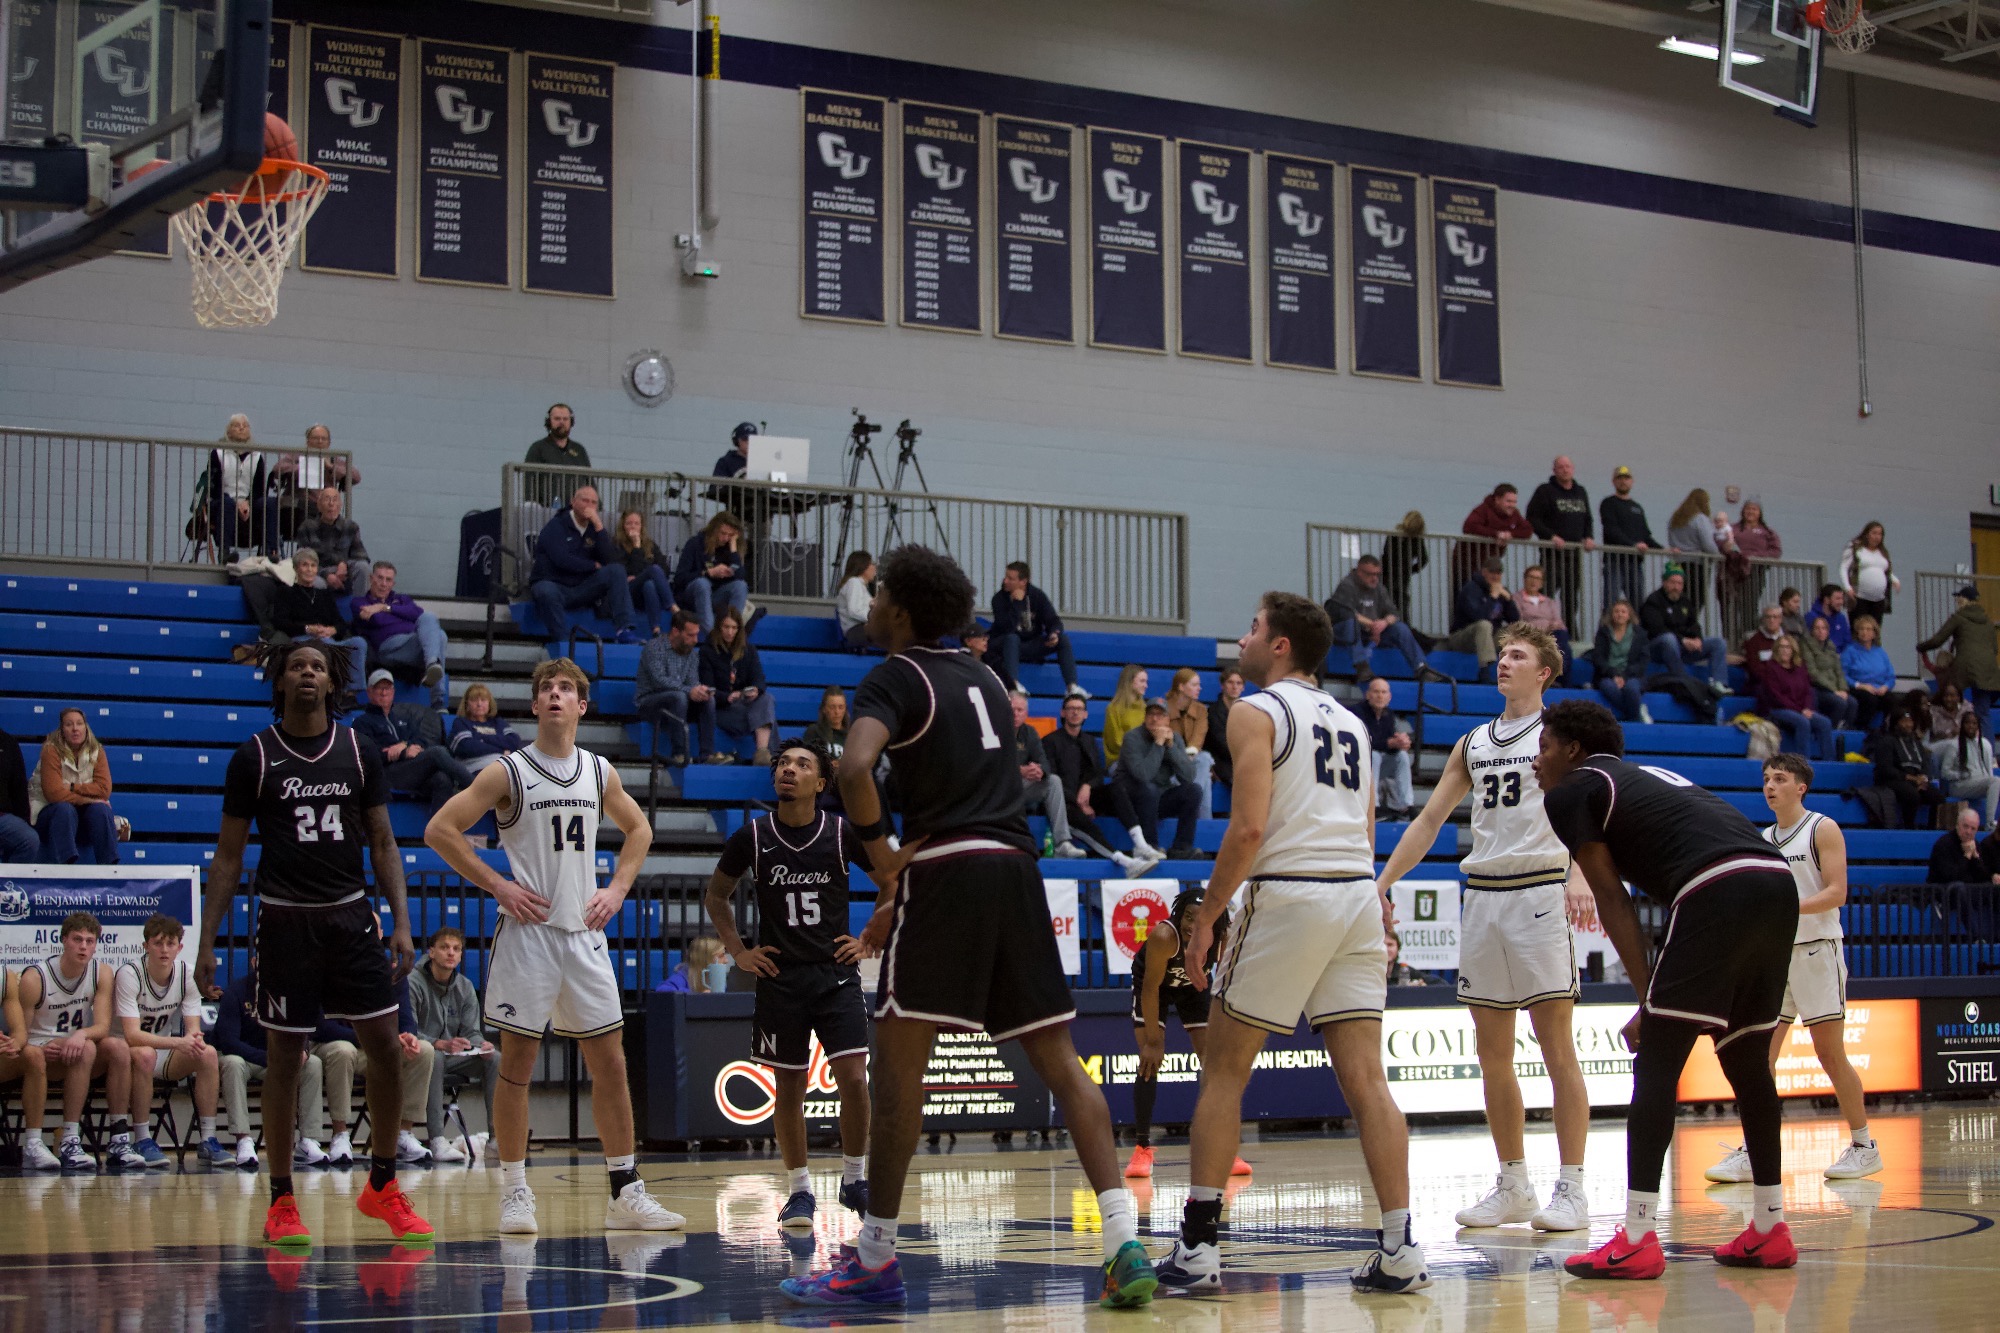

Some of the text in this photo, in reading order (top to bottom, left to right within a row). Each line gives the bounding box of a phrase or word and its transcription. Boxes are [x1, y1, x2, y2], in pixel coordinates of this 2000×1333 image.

[327, 40, 385, 57] WOMEN'S
[328, 54, 383, 69] OUTDOOR
[435, 53, 495, 70] WOMEN'S
[314, 62, 397, 81] TRACK & FIELD
[425, 65, 504, 84] VOLLEYBALL
[542, 68, 600, 84] WOMEN'S
[532, 79, 609, 98] VOLLEYBALL
[95, 111, 149, 124] TOURNAMEN
[826, 104, 862, 118] MEN'S
[807, 113, 881, 131] BASKETBALL
[924, 115, 958, 130] MEN'S
[905, 125, 977, 143] BASKETBALL
[1018, 130, 1050, 144] MEN'S
[336, 138, 372, 152] WHAC
[453, 141, 476, 151] WHAC
[318, 149, 388, 166] CHAMPIONS
[430, 156, 498, 172] CHAMPIONS
[328, 172, 349, 183] 002
[436, 178, 460, 188] 1997
[537, 169, 604, 185] CHAMPIONS
[328, 183, 349, 193] 004
[812, 200, 875, 215] CHAMPIONS
[910, 209, 972, 225] CHAMPIONS
[1020, 212, 1050, 225] WHAC
[1005, 223, 1064, 238] CHAMPIONS
[1099, 232, 1156, 248] CHAMPIONS
[1187, 244, 1243, 260] CHAMPIONS
[1274, 255, 1328, 271] CHAMPIONS
[968, 687, 1001, 749] 1
[1312, 723, 1361, 792] 23
[281, 777, 351, 799] Racers
[1483, 772, 1521, 809] 33
[529, 798, 596, 811] CORNERSTONE
[295, 805, 345, 842] 24
[551, 814, 585, 852] 14
[769, 865, 831, 885] Racers
[35, 894, 91, 907] BENJAMIN
[95, 896, 103, 907] F.
[1119, 889, 1163, 907] COUSIN'S
[785, 891, 821, 926] 15
[36, 930, 47, 943] Al
[5, 944, 40, 955] President
[104, 945, 132, 955] Branch
[56, 1009, 83, 1033] 24
[1936, 1023, 2000, 1037] NORTHCOAS
[928, 1058, 1006, 1069] 4494 Plainfield Ave.
[1947, 1059, 1998, 1084] STIFEL
[944, 1072, 974, 1084] Rapids,
[975, 1072, 987, 1082] MI
[988, 1071, 1015, 1082] 49525
[1399, 1065, 1455, 1080] SERVICE
[930, 1094, 952, 1102] YOU'VE
[953, 1093, 971, 1101] TRIED
[971, 1093, 983, 1101] THE
[944, 1103, 964, 1115] EAT
[966, 1103, 987, 1114] THE
[987, 1102, 1016, 1113] BEST!
